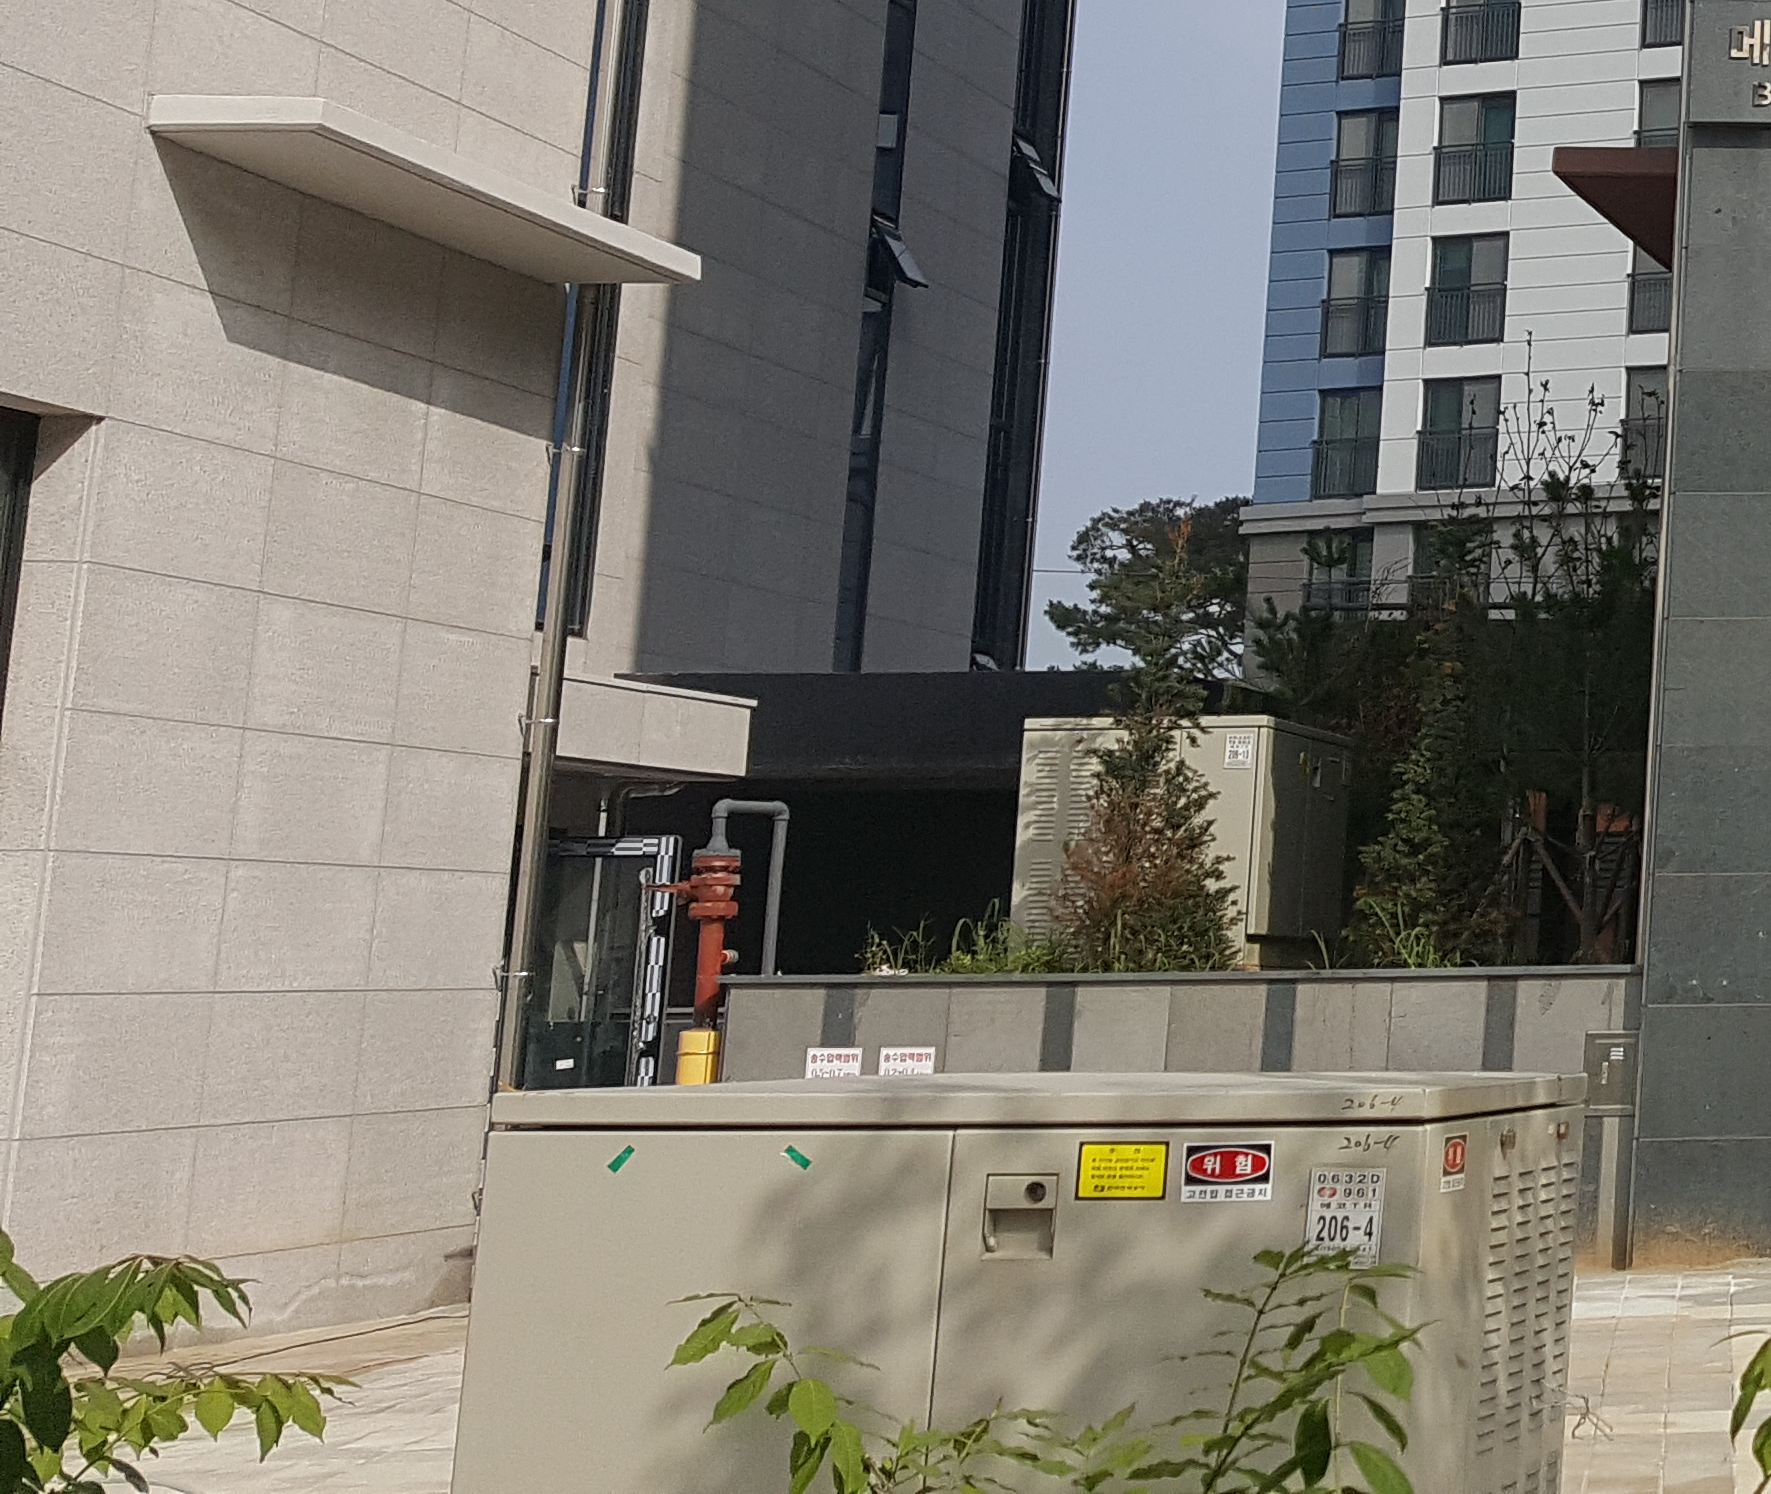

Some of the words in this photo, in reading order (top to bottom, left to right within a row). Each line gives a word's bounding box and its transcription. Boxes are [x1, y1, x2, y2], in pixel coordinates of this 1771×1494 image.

[1203, 1154, 1252, 1175] 위험
[1187, 1189, 1218, 1199] 고전압
[1224, 1188, 1267, 1199] 접근금지
[1316, 1215, 1374, 1242] 206-4
